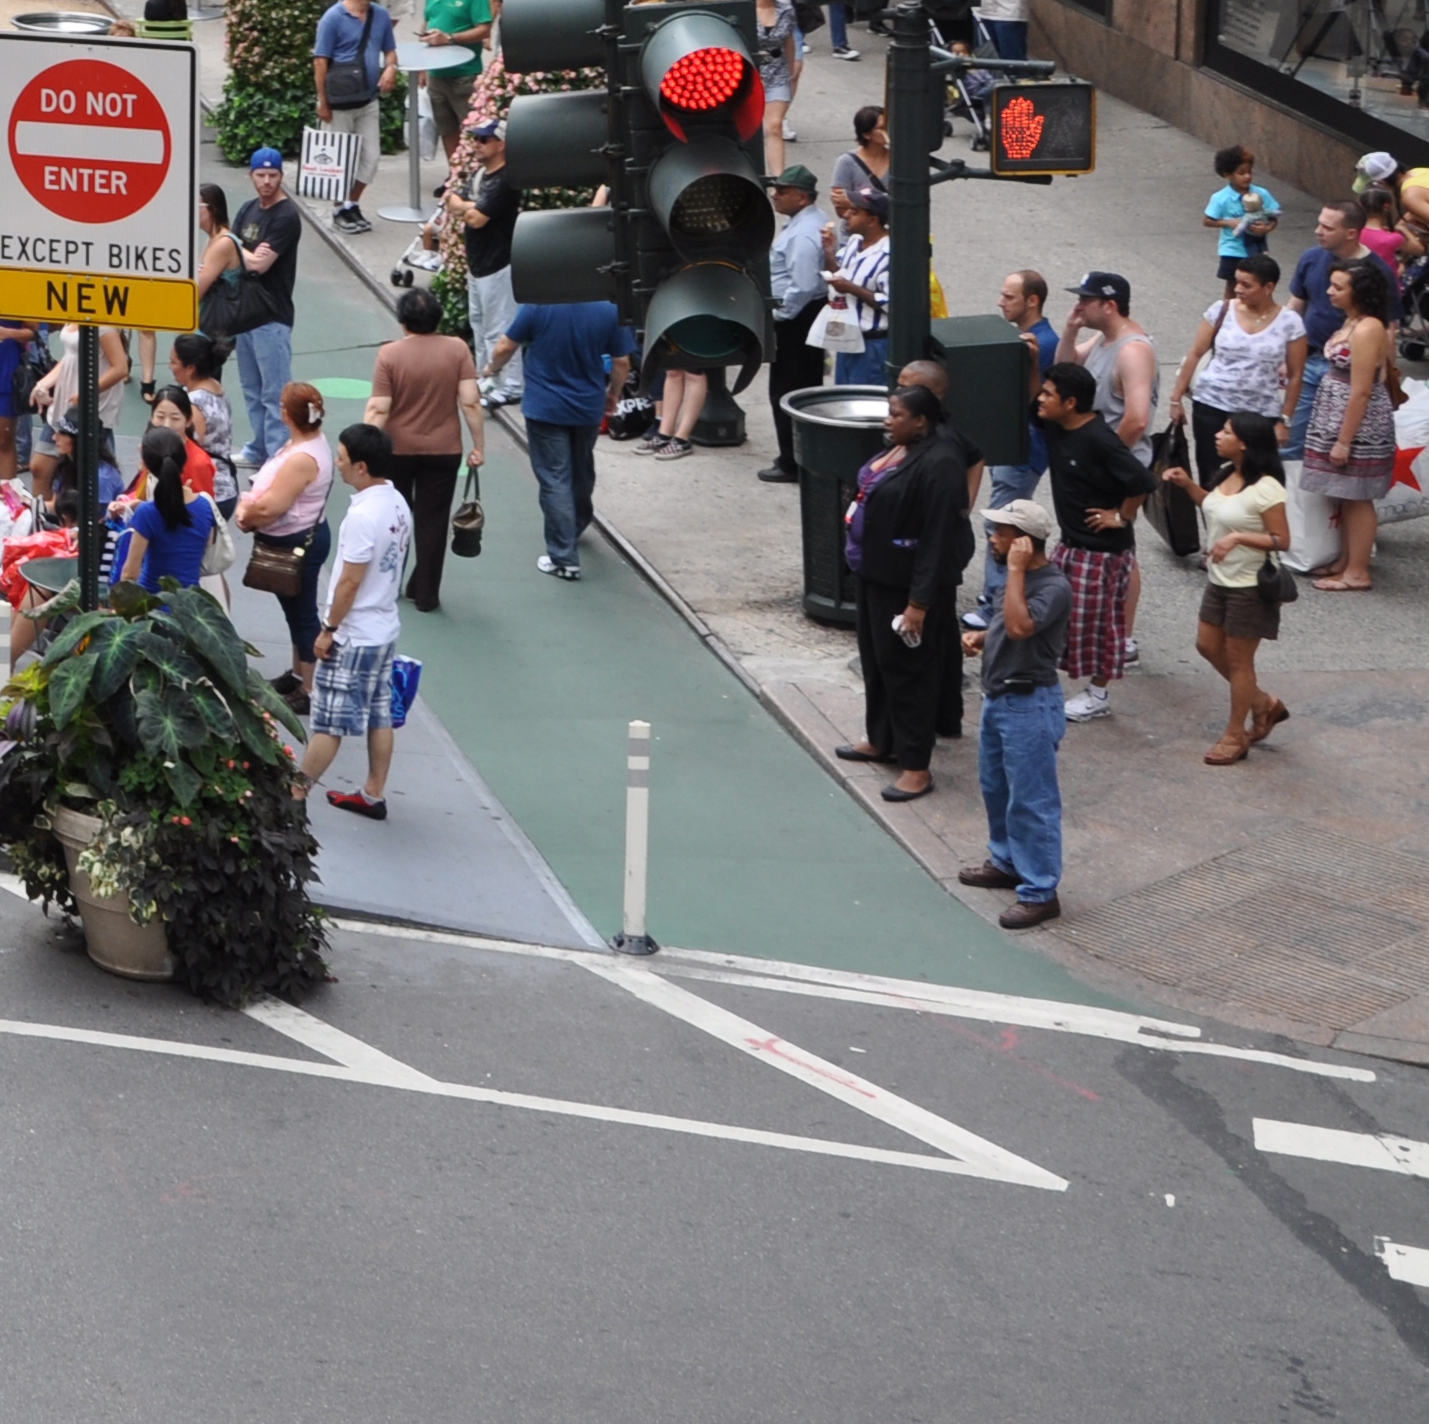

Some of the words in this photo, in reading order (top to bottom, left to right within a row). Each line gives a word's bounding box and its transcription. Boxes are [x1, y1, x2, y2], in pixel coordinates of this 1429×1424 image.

[41, 88, 76, 114] DO
[86, 91, 137, 118] NOT
[43, 166, 128, 196] ENTER
[0, 235, 95, 266] EXCEPT
[108, 243, 183, 274] BIKES
[46, 280, 130, 317] NEW
